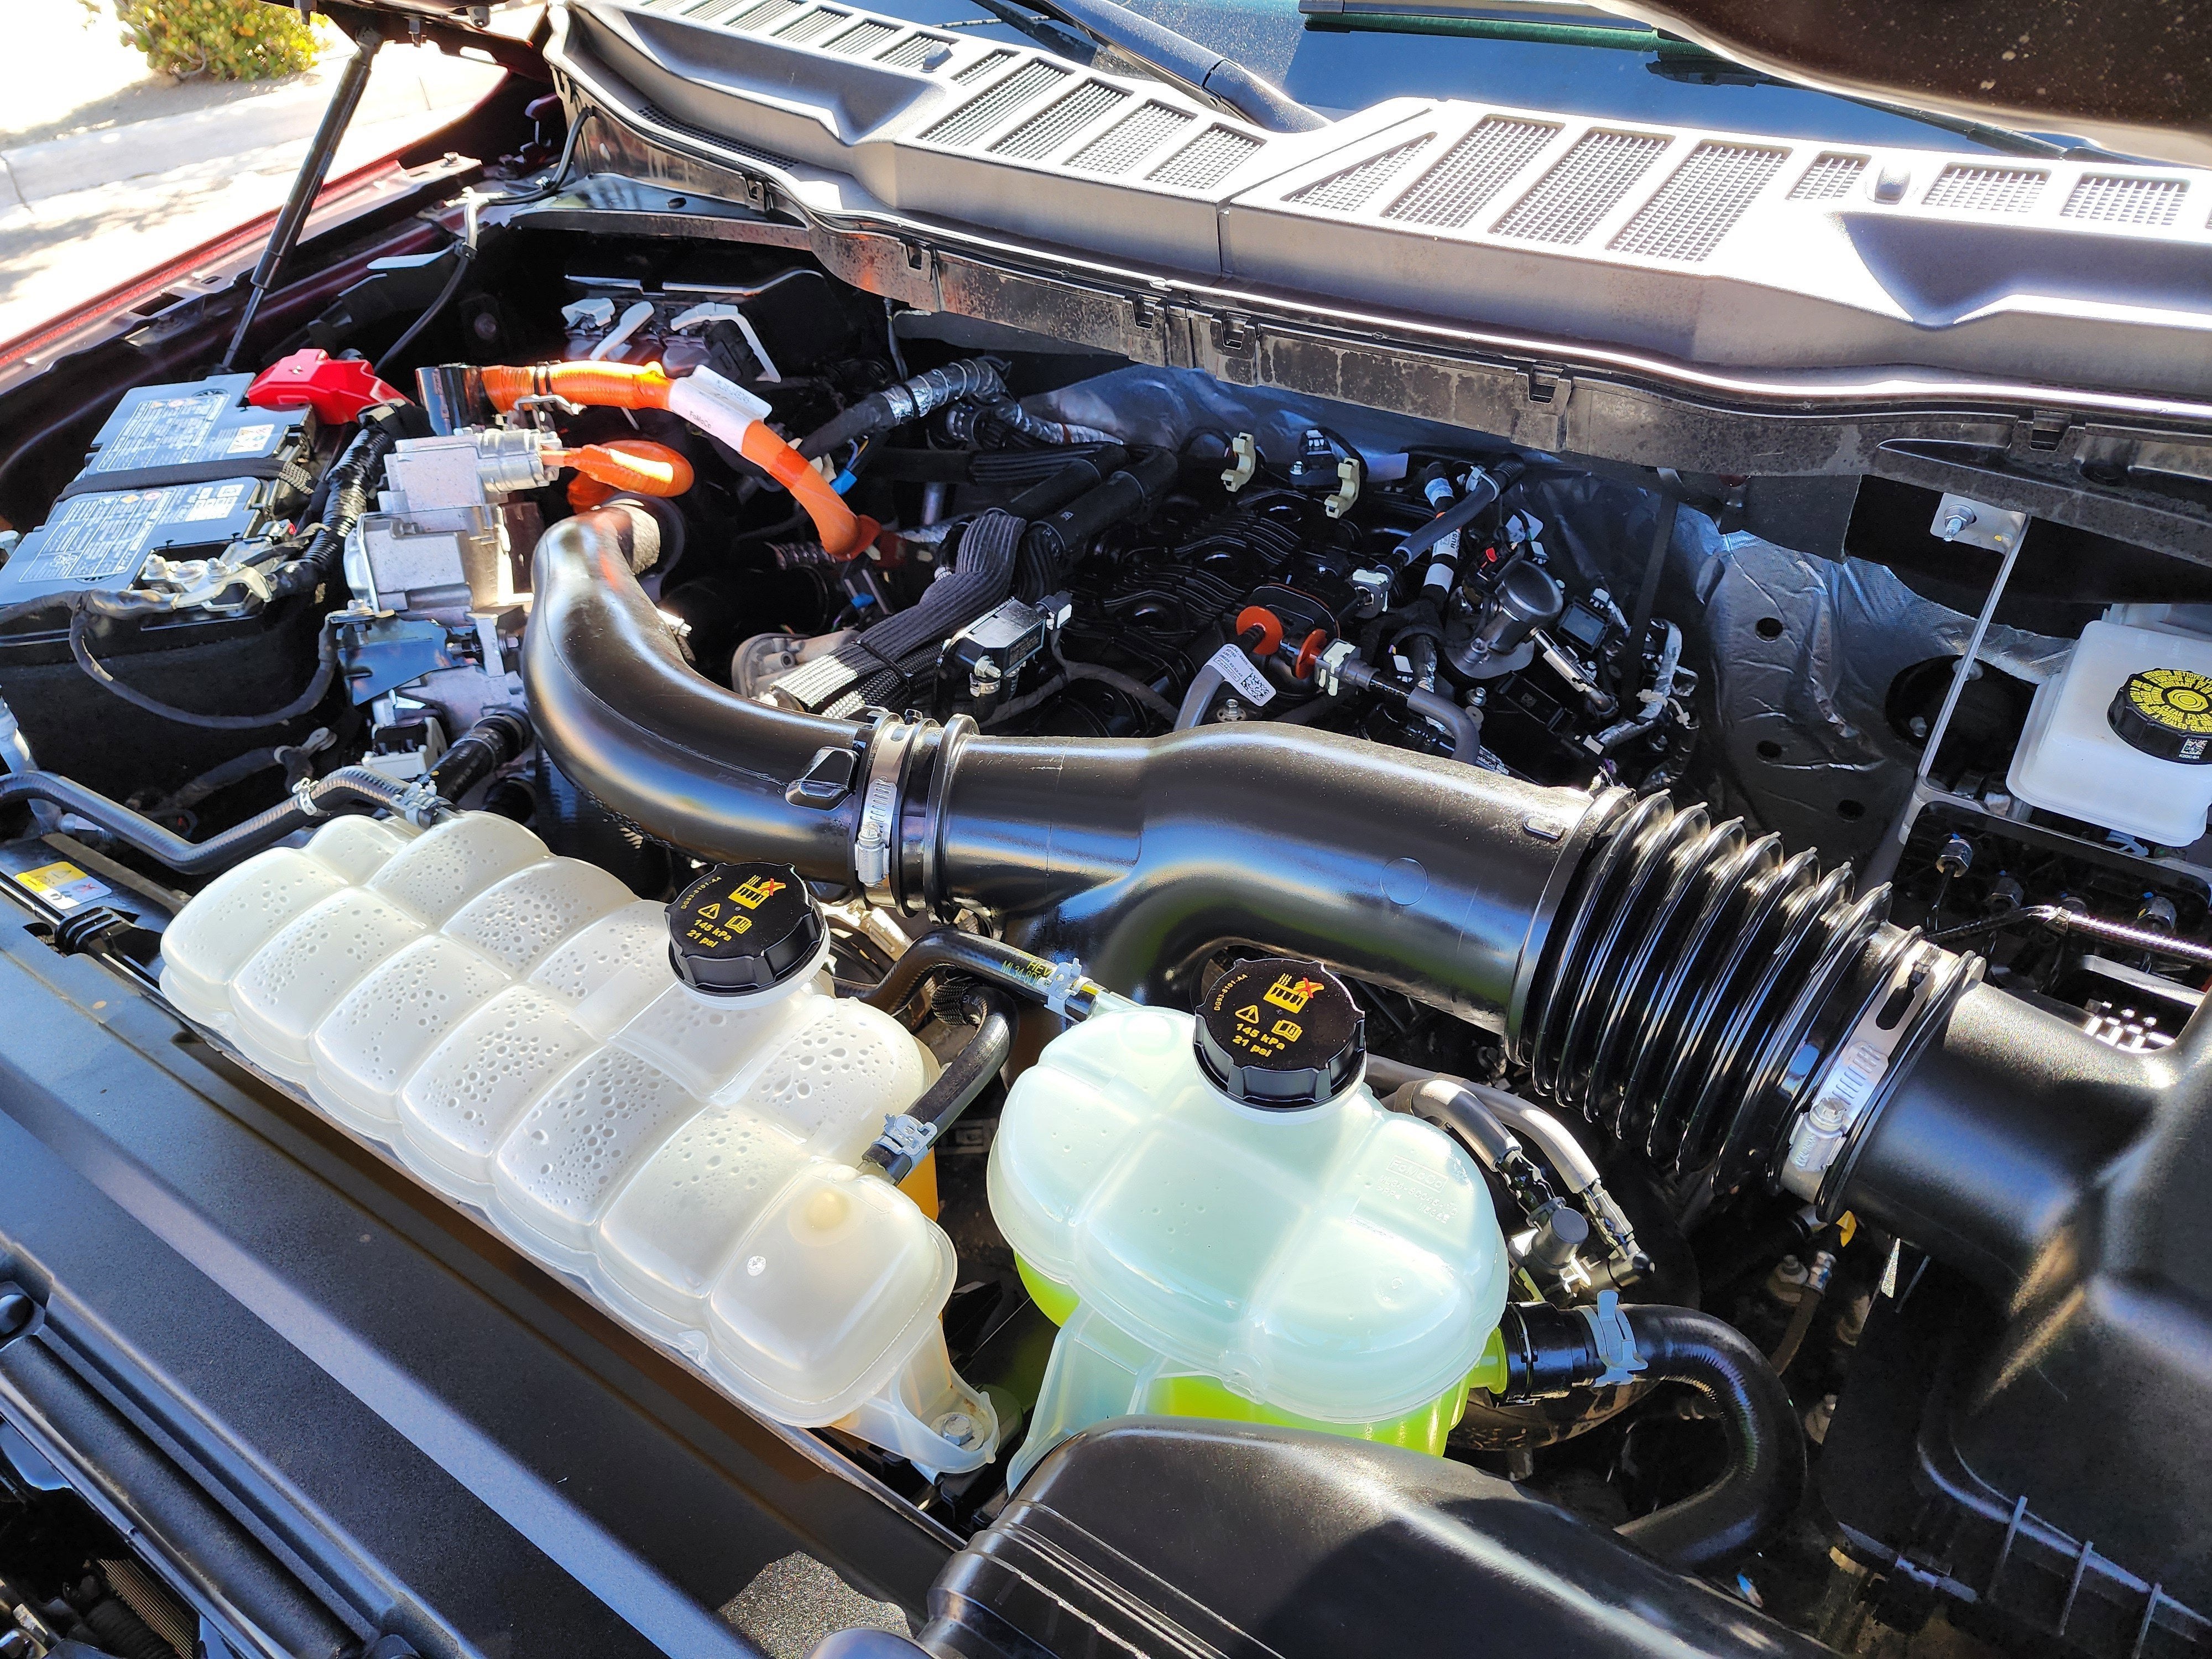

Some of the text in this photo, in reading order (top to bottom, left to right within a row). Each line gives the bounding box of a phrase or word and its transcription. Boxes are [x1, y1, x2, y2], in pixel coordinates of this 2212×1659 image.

[689, 411, 712, 429] FoMoCo
[2130, 679, 2143, 688] DOT
[2142, 670, 2172, 680] ATTENTION
[2173, 670, 2206, 681] NETTOYER
[2141, 682, 2153, 691] CAP
[2129, 690, 2143, 702] FLUID
[2140, 690, 2156, 705] BEFORE
[2136, 703, 2155, 715] FROM
[2150, 705, 2183, 723] REMOVING
[2161, 705, 2185, 718] CLEAN
[2159, 717, 2187, 730] SEALED
[680, 877, 722, 909] DG93-8101-AA
[686, 929, 719, 948] 21 psi
[693, 919, 732, 942] 145 kPa
[1026, 961, 1052, 977] HEV
[1214, 974, 1248, 1011] DG93-8101-AA
[1237, 1023, 1285, 1050] 145 kPa
[1233, 1035, 1272, 1057] 21 psi
